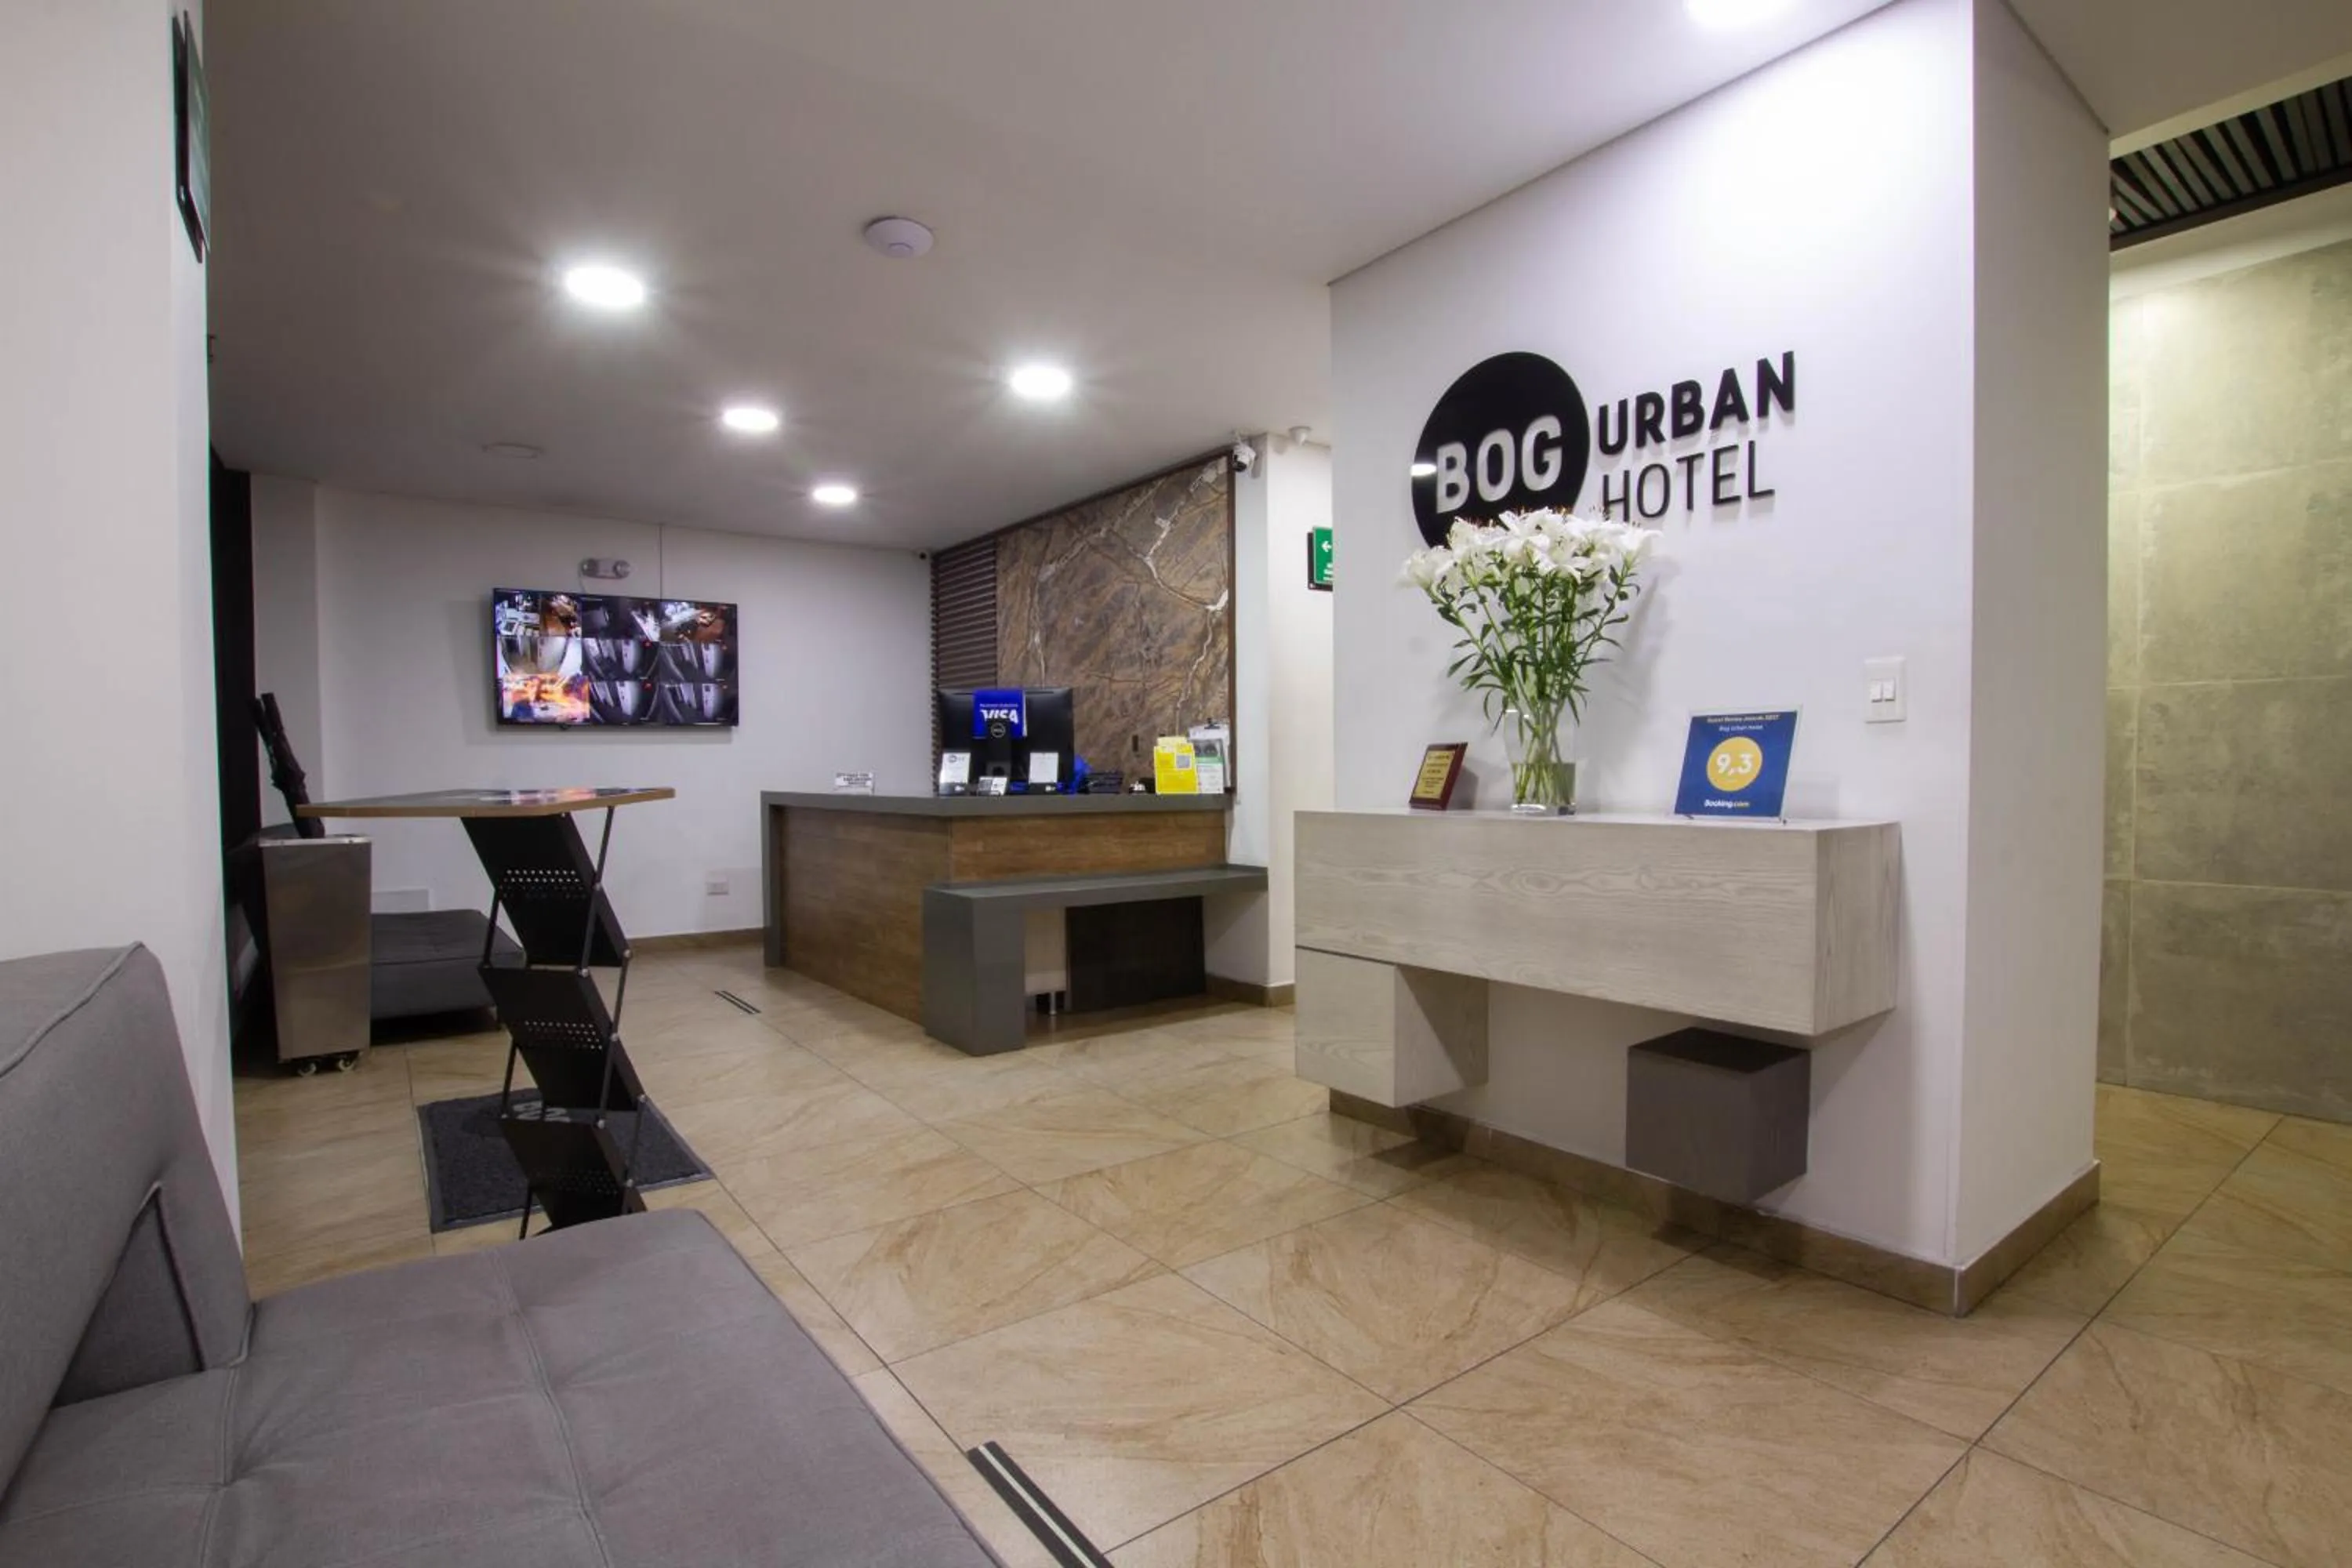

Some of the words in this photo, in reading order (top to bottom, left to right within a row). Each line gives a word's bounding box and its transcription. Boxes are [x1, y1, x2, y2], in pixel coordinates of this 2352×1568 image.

[1599, 350, 1795, 455] URBAN
[1436, 414, 1563, 514] BOG
[1602, 440, 1775, 522] HOTEL
[1704, 799, 1750, 809] Booking.com
